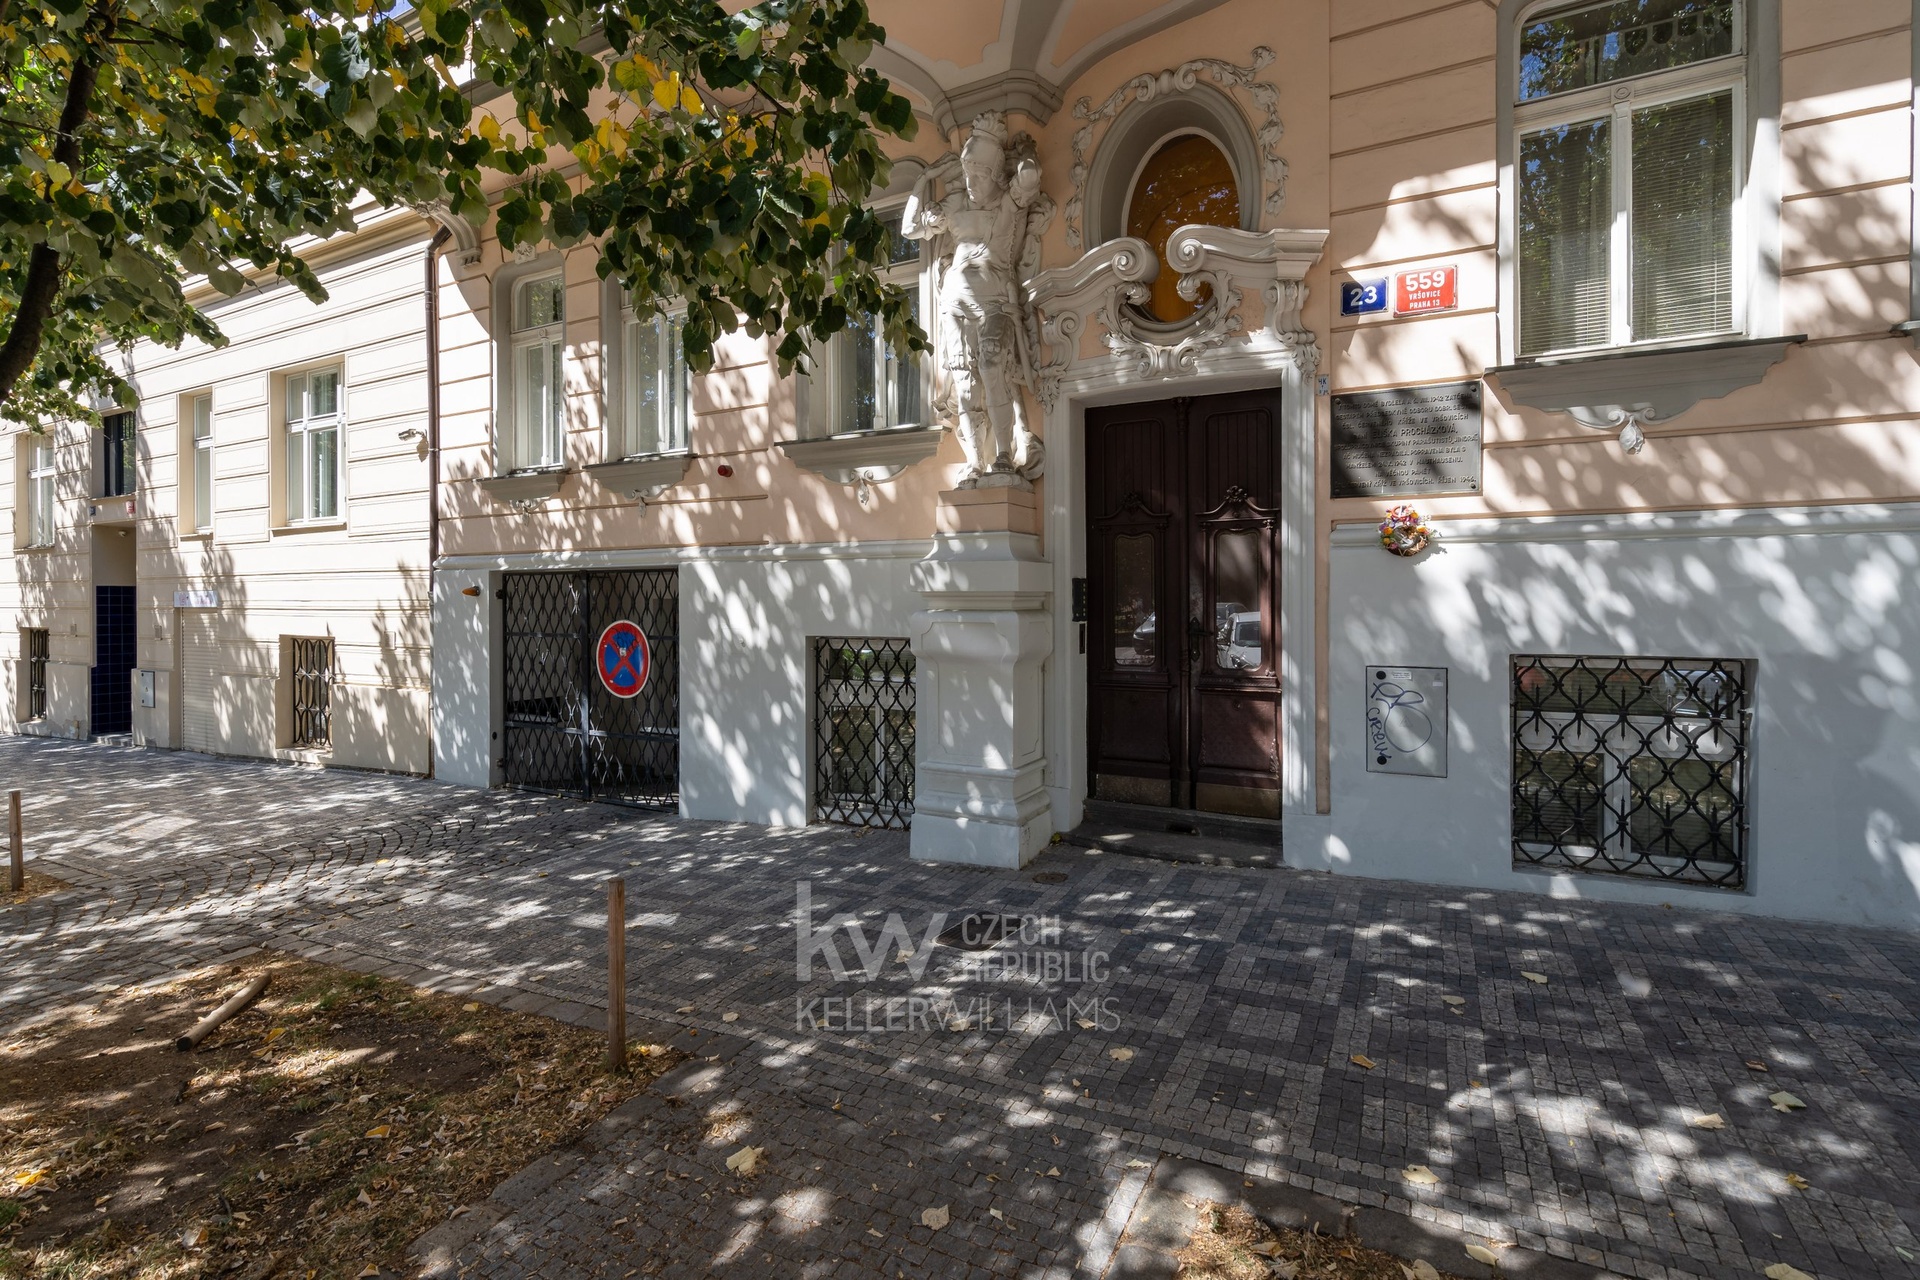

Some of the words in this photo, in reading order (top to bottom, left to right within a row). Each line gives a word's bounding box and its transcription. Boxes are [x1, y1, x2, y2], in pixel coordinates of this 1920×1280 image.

[1405, 270, 1445, 292] 559
[1350, 285, 1378, 307] 23
[1408, 290, 1440, 301] VRŠOVICE
[1409, 300, 1431, 310] PRAHA
[1432, 412, 1469, 423] VRŠOVICÍCH
[1373, 427, 1398, 439] ELIŠKA
